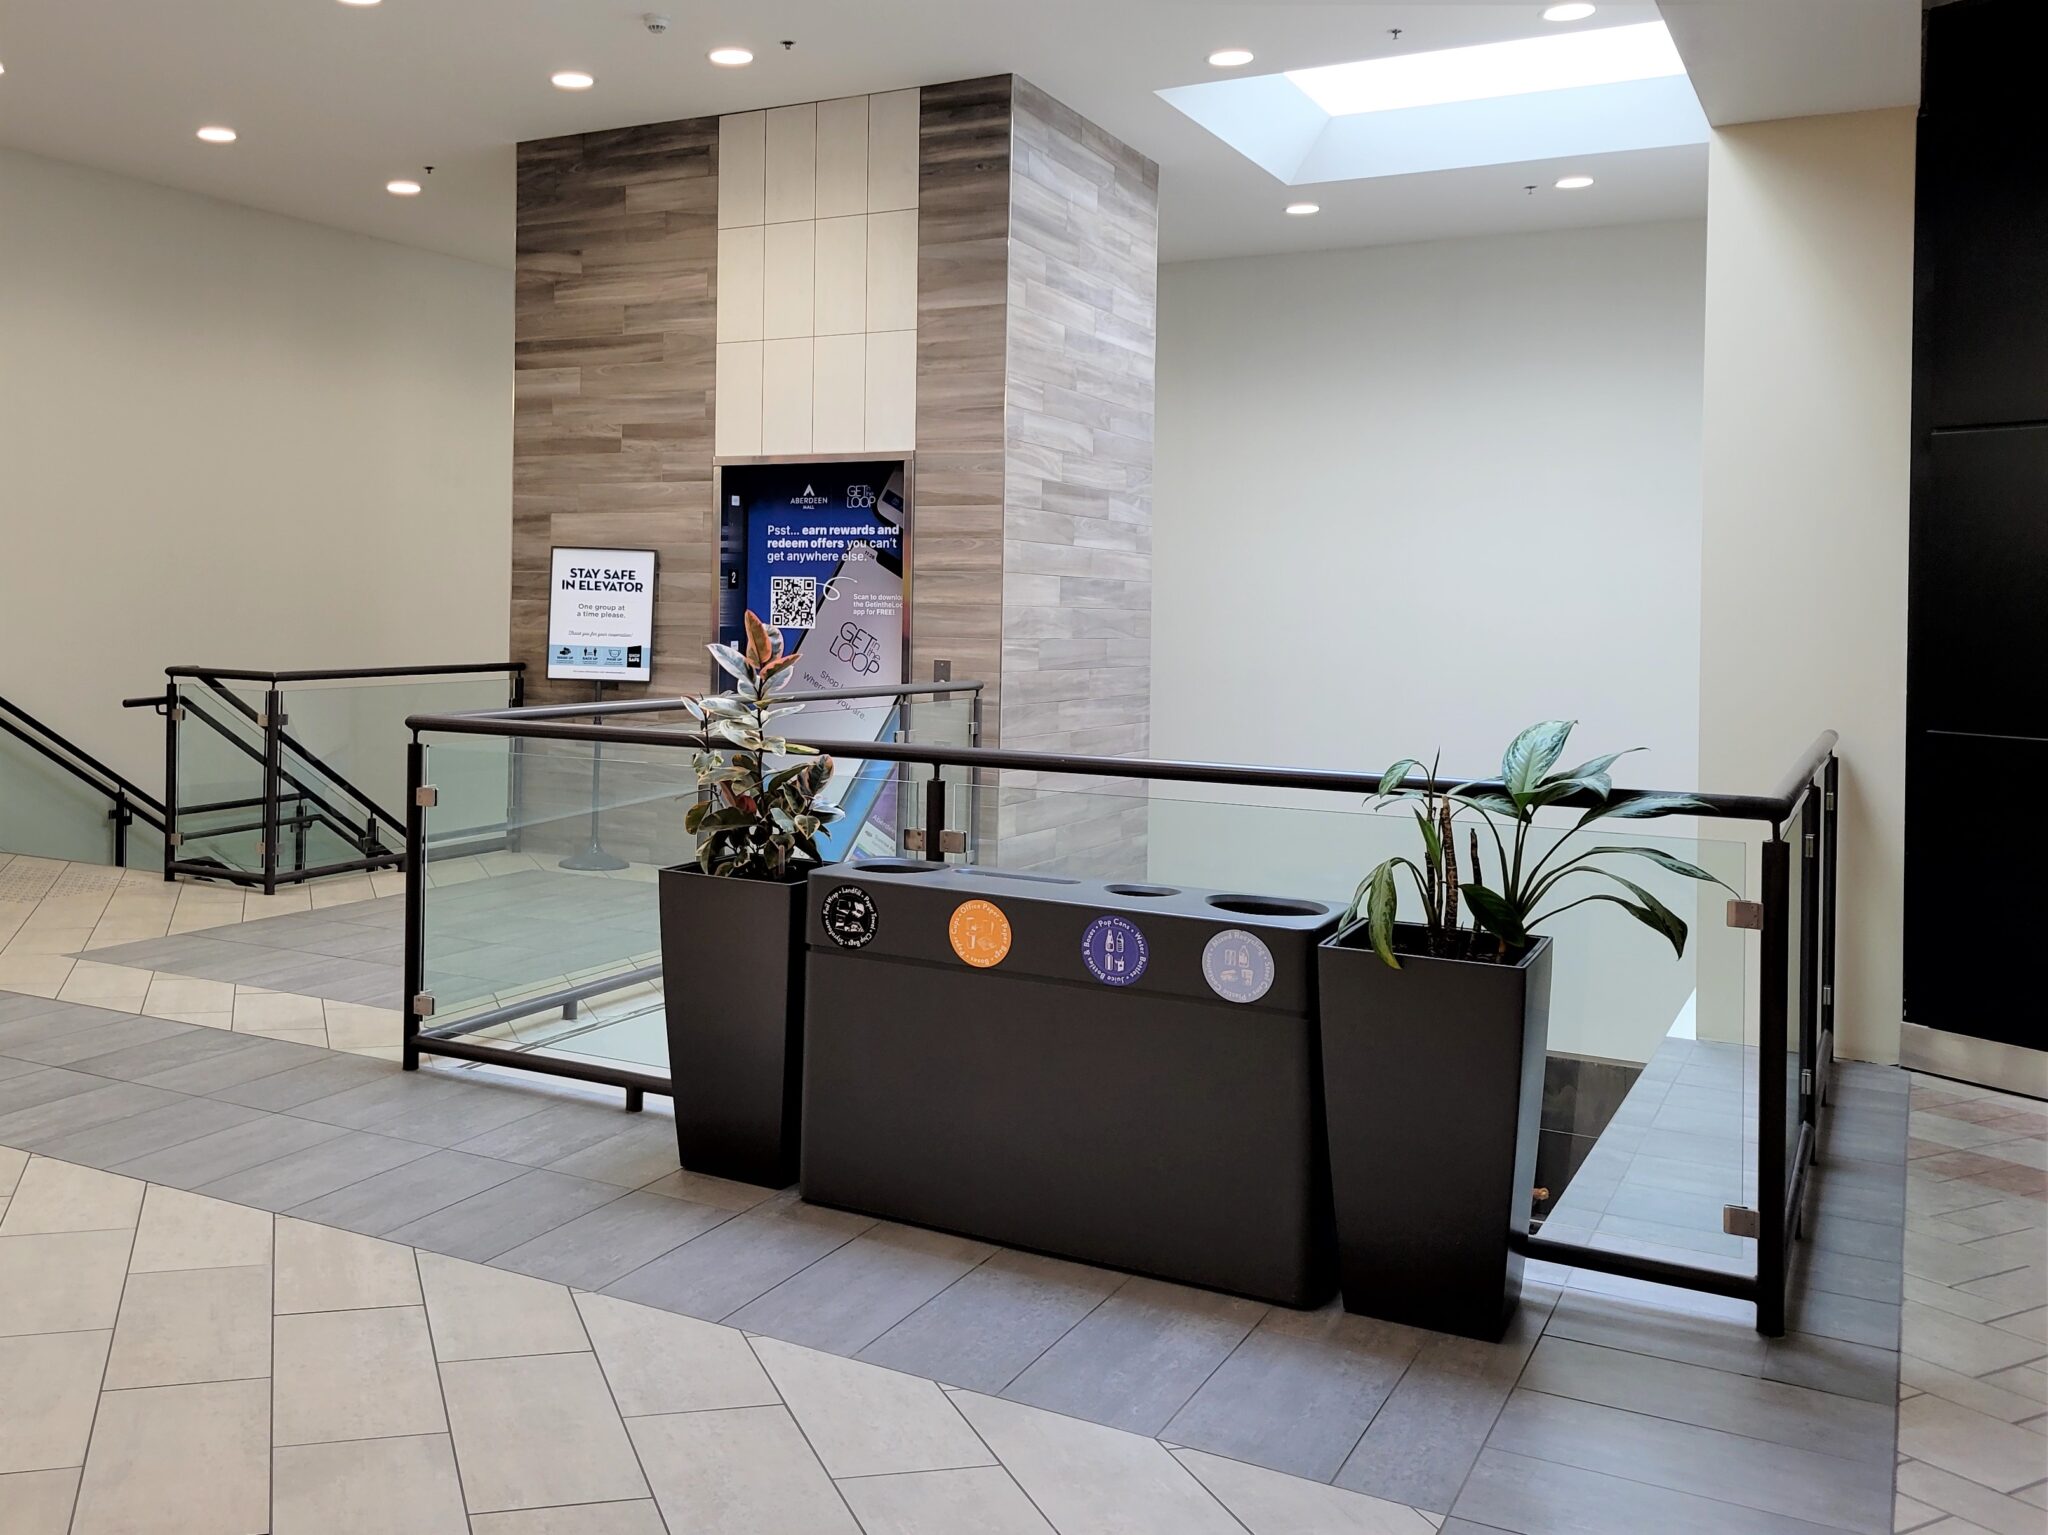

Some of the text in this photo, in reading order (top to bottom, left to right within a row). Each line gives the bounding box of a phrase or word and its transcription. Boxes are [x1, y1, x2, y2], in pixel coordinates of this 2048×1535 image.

[847, 485, 867, 497] GET
[790, 497, 828, 505] ABERDEEN
[847, 496, 875, 508] LOOP
[767, 524, 899, 536] Psst... earn rewards and
[767, 537, 897, 551] redeem offers you can't
[767, 550, 868, 564] get anywhere else.
[569, 568, 636, 580] STAY SAFE
[731, 572, 737, 584] 2
[562, 579, 644, 593] IN ELEVATOR
[594, 604, 616, 612] group
[876, 608, 896, 616] FREE!
[840, 622, 877, 653] GET
[830, 635, 880, 676] LOOP
[820, 670, 839, 688] Shop
[826, 892, 839, 904] Wrap
[841, 887, 862, 896] Landfill
[863, 896, 875, 912] Paper
[960, 903, 1000, 918] Office Paper
[1113, 918, 1130, 930] Cans
[825, 919, 845, 945] Styrofoam
[951, 918, 966, 956] Paper Cups
[1083, 928, 1096, 947] Boxes
[847, 932, 872, 947] Chip Bags
[1211, 931, 1266, 957] Mixed Recycling
[1129, 932, 1147, 978] Water Bottles
[1087, 957, 1106, 980] Bottles
[1106, 976, 1125, 984] Juice
[1206, 953, 1247, 1001] Plastic Containers
[1252, 961, 1272, 996] Steel Cans
